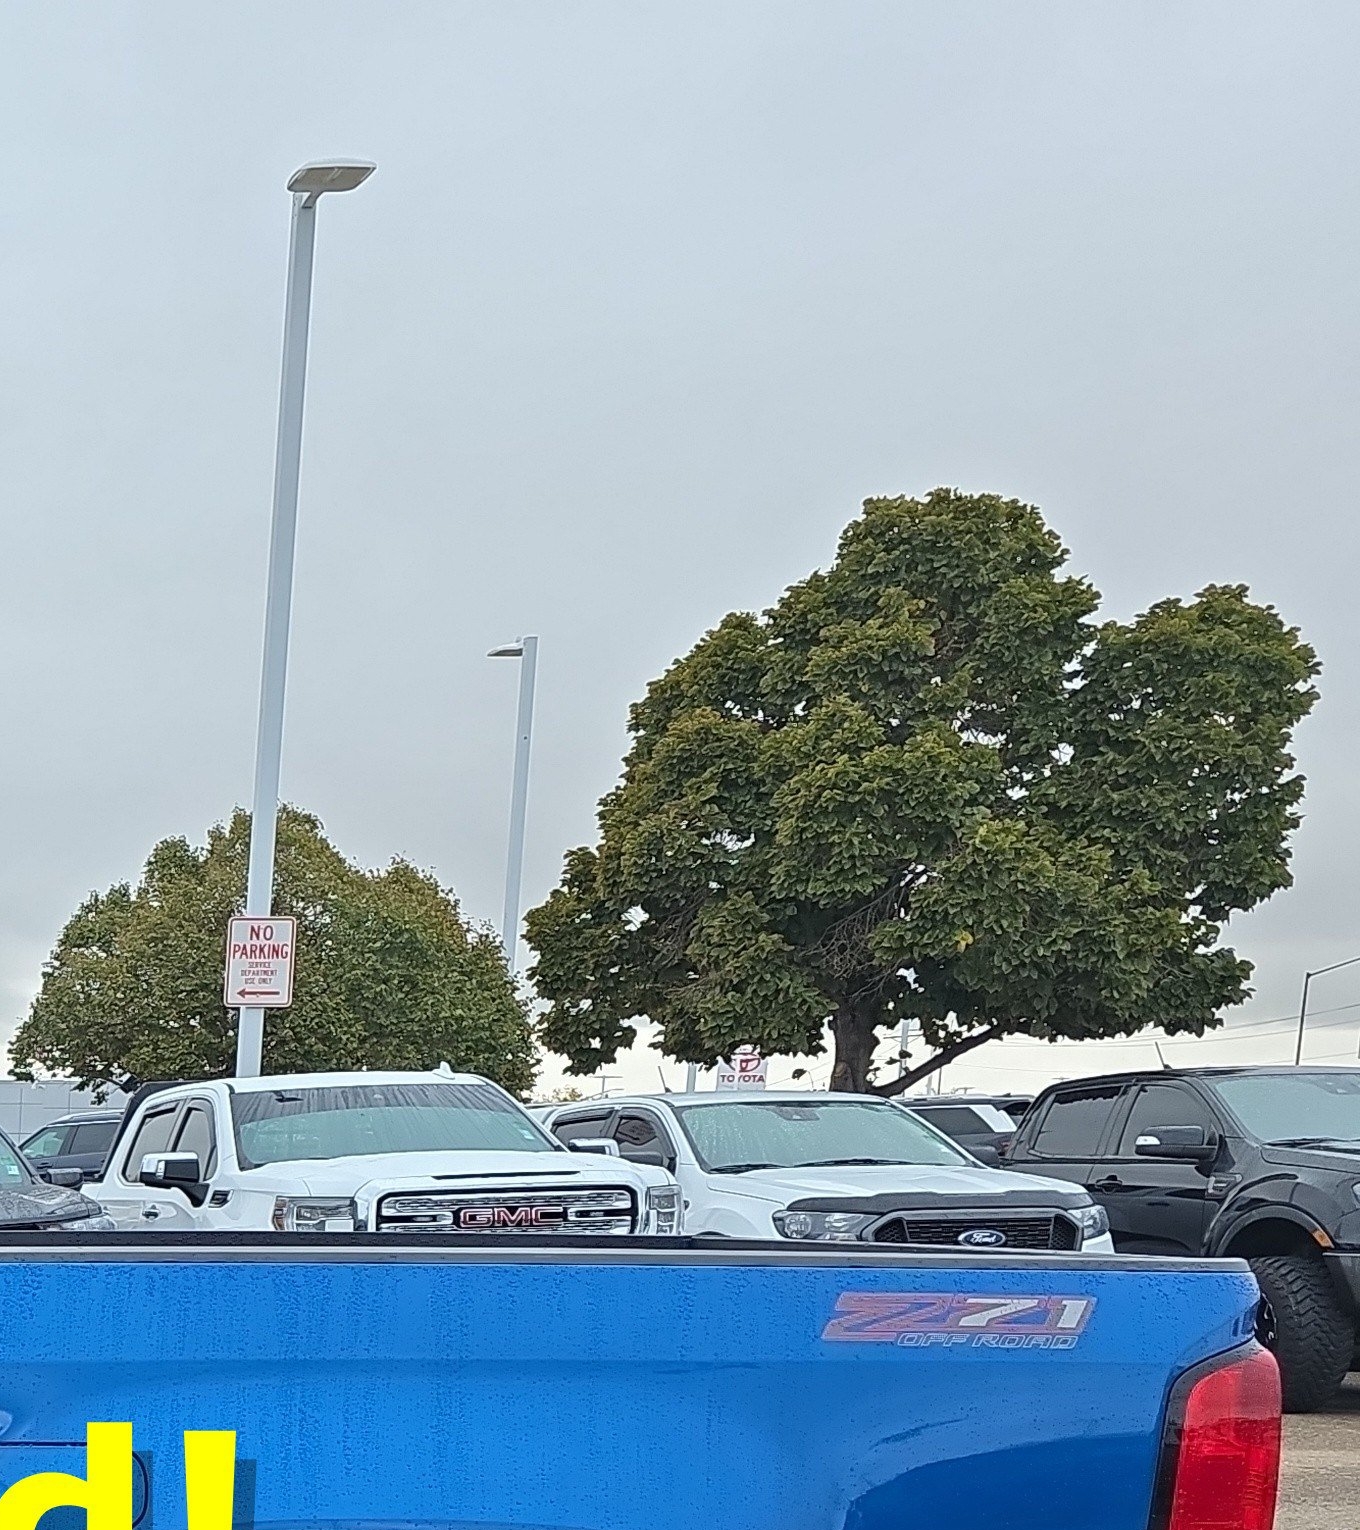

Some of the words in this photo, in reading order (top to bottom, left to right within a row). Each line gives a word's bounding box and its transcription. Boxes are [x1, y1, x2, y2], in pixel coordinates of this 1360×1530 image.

[249, 924, 274, 941] NO
[232, 943, 289, 960] PARKING
[241, 969, 278, 977] DEPARTMENT
[248, 961, 272, 969] SERVICE
[460, 1206, 564, 1228] GMC
[821, 1291, 1098, 1341] Z71
[897, 1332, 970, 1348] OFF
[972, 1332, 1080, 1350] ROAD
